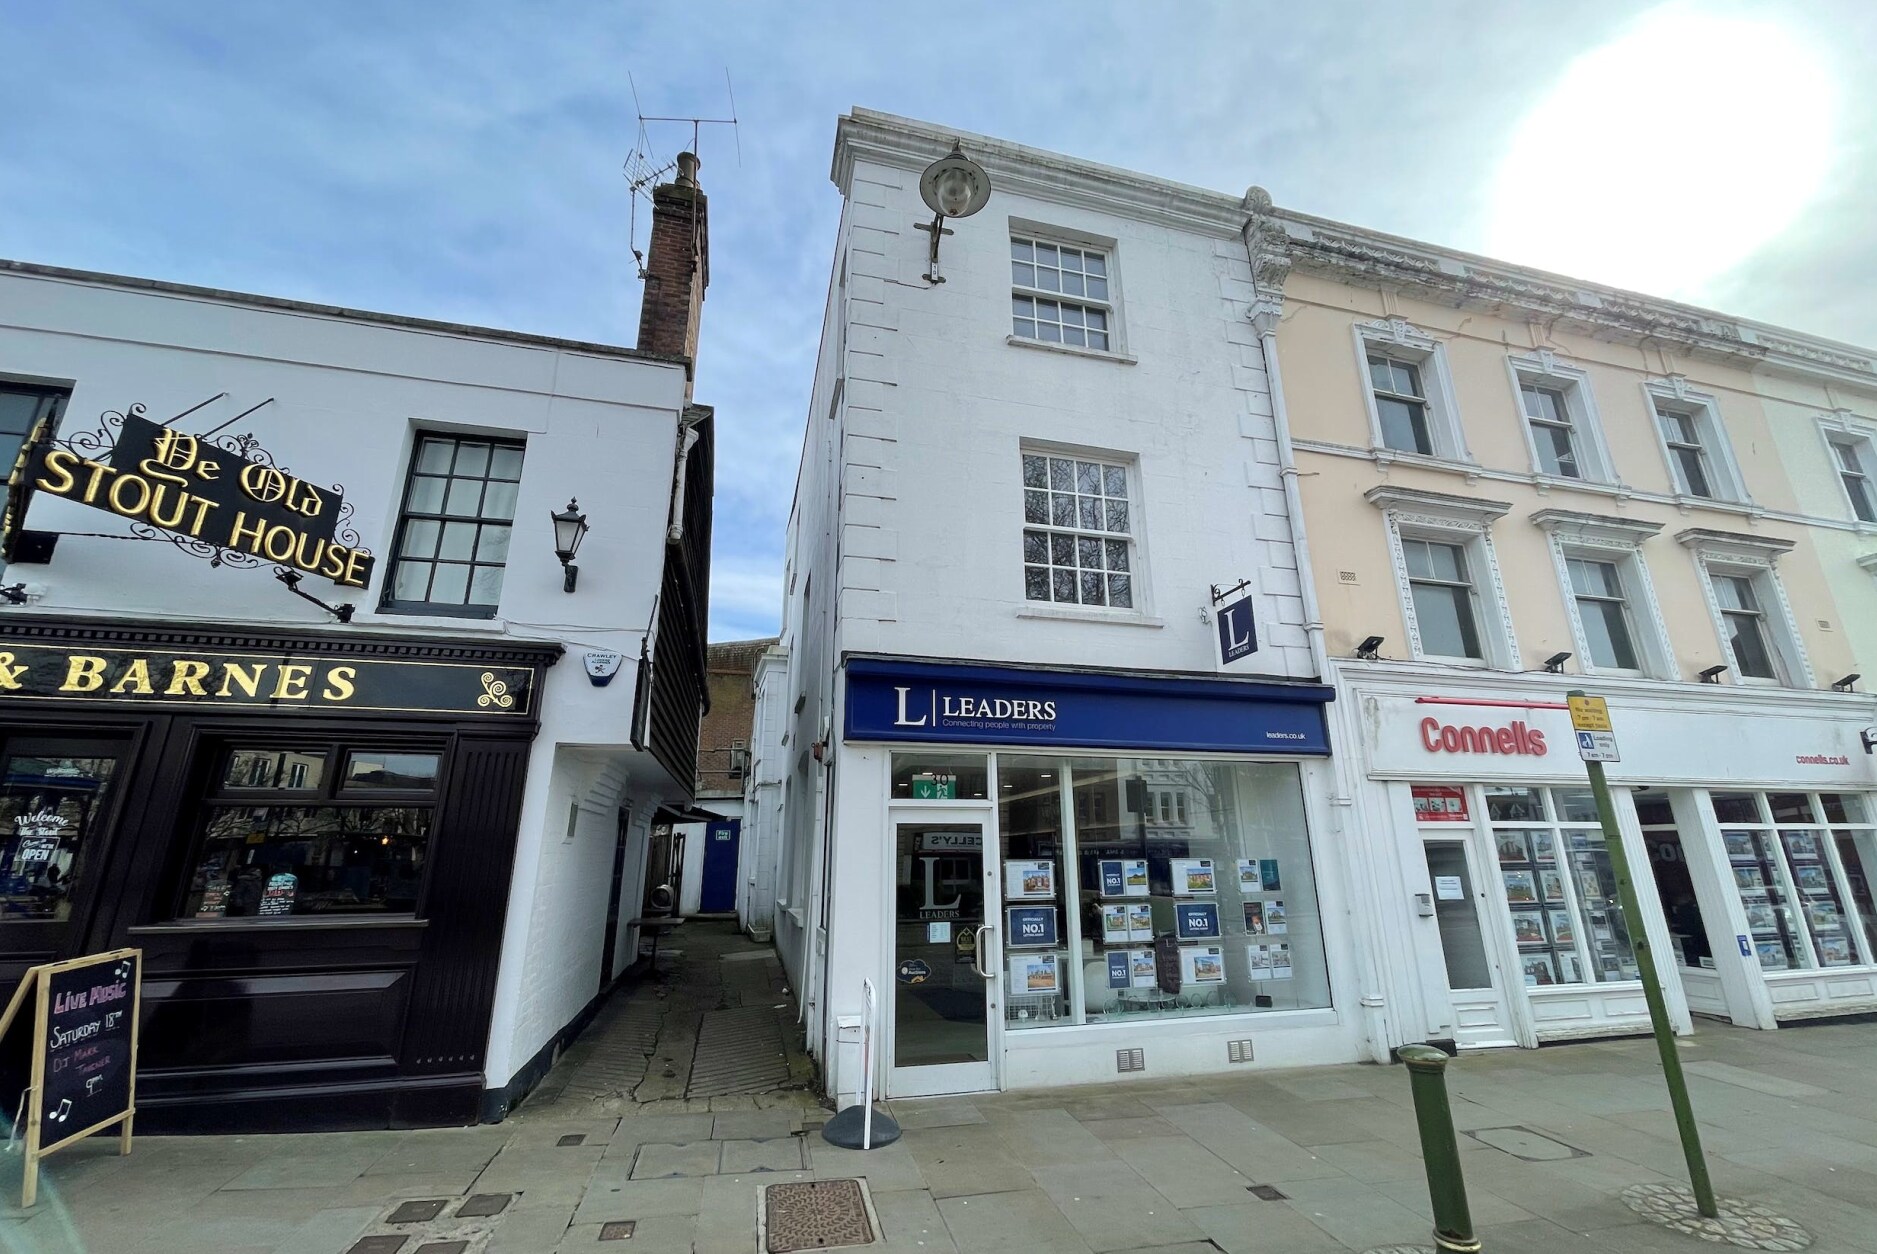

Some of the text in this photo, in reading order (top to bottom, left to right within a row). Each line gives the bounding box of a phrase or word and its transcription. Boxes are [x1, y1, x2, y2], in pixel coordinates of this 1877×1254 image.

[239, 461, 323, 517] Old
[36, 450, 220, 537] STOUT
[229, 511, 372, 585] HOUSE
[1224, 609, 1249, 651] L
[1228, 645, 1250, 657] LEADERS
[58, 655, 357, 700] BARNES
[894, 686, 1057, 726] L LEADERS
[942, 718, 1056, 732] Connecting people with property
[1266, 731, 1306, 740] leaders.co.uk
[1420, 716, 1547, 756] Connells
[1796, 754, 1850, 765] connells.co.uk
[930, 774, 949, 786] 30
[14, 810, 69, 827] Welcome
[22, 848, 49, 860] OPEN
[919, 857, 962, 909] L
[919, 909, 960, 919] LEADERS
[1023, 924, 1044, 933] NO.1
[1188, 918, 1208, 928] NO.1
[50, 1021, 101, 1049] SATURDAY
